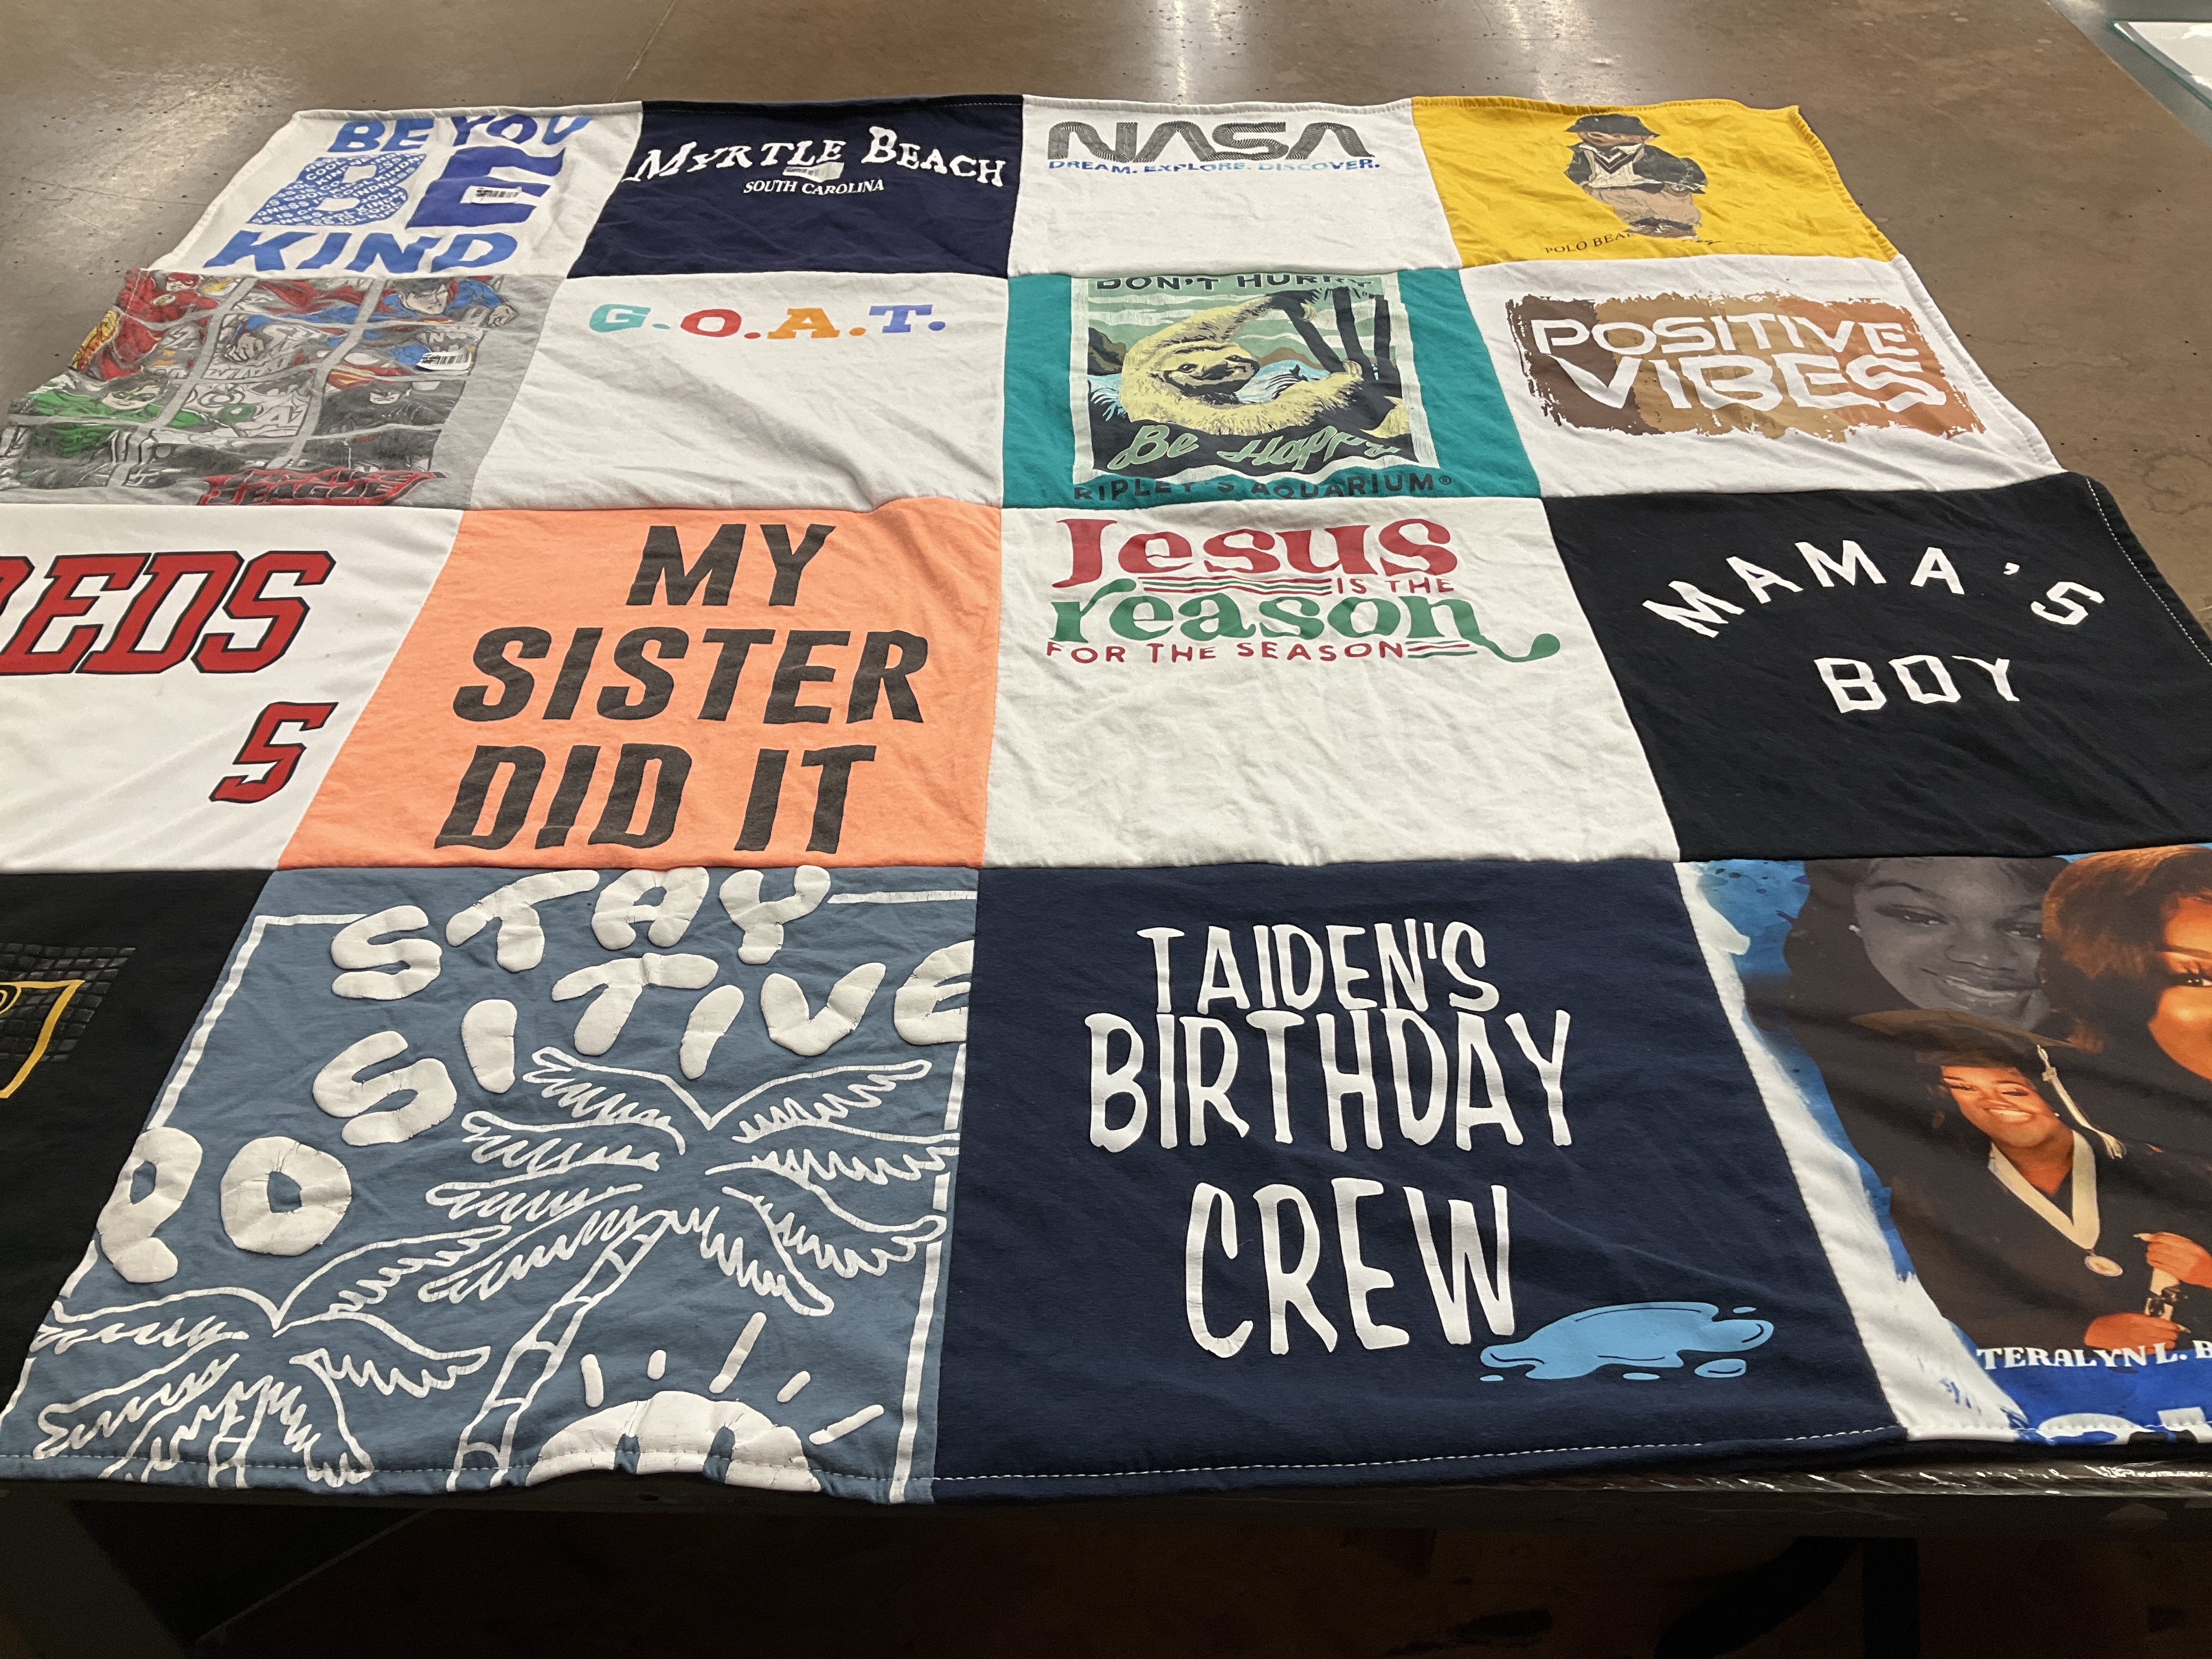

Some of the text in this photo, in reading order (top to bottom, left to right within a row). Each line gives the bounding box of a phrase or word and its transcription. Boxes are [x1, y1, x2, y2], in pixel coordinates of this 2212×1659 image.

[326, 114, 594, 153] BE YOU
[621, 126, 1006, 187] MYRTLE BEACH
[1047, 120, 1376, 163] NASA
[743, 179, 885, 195] SOUTH CAROLINA
[1049, 158, 1381, 174] DREAM. EXPLORE. DISCOVER.
[203, 230, 518, 274] KIND
[1545, 241, 1588, 253] POLO
[1097, 275, 1217, 291] DON'T
[589, 303, 946, 340] G.O.A.T.
[1530, 312, 1920, 356] POSITIVE
[1546, 352, 1948, 413] VIBES
[1107, 425, 1402, 471] Be Happy
[625, 523, 836, 606] MY
[1051, 518, 1458, 588] Jesus
[1336, 577, 1456, 595] IS THE
[1642, 540, 2105, 638] MAMA'S
[1050, 577, 1561, 664] reason
[453, 625, 928, 724] SISTER
[1046, 641, 1403, 664] FOR THE SEASON
[1814, 654, 2020, 713] BOY
[433, 742, 877, 854] DID IT
[330, 865, 831, 1000] STAY
[1136, 917, 1500, 1014] TAIDEN'S
[1084, 1007, 1572, 1153] BIRTHDAY
[1185, 1176, 1517, 1359] CREW
[1976, 1345, 2148, 1370] TERALYN
[2152, 1342, 2188, 1365] L.
